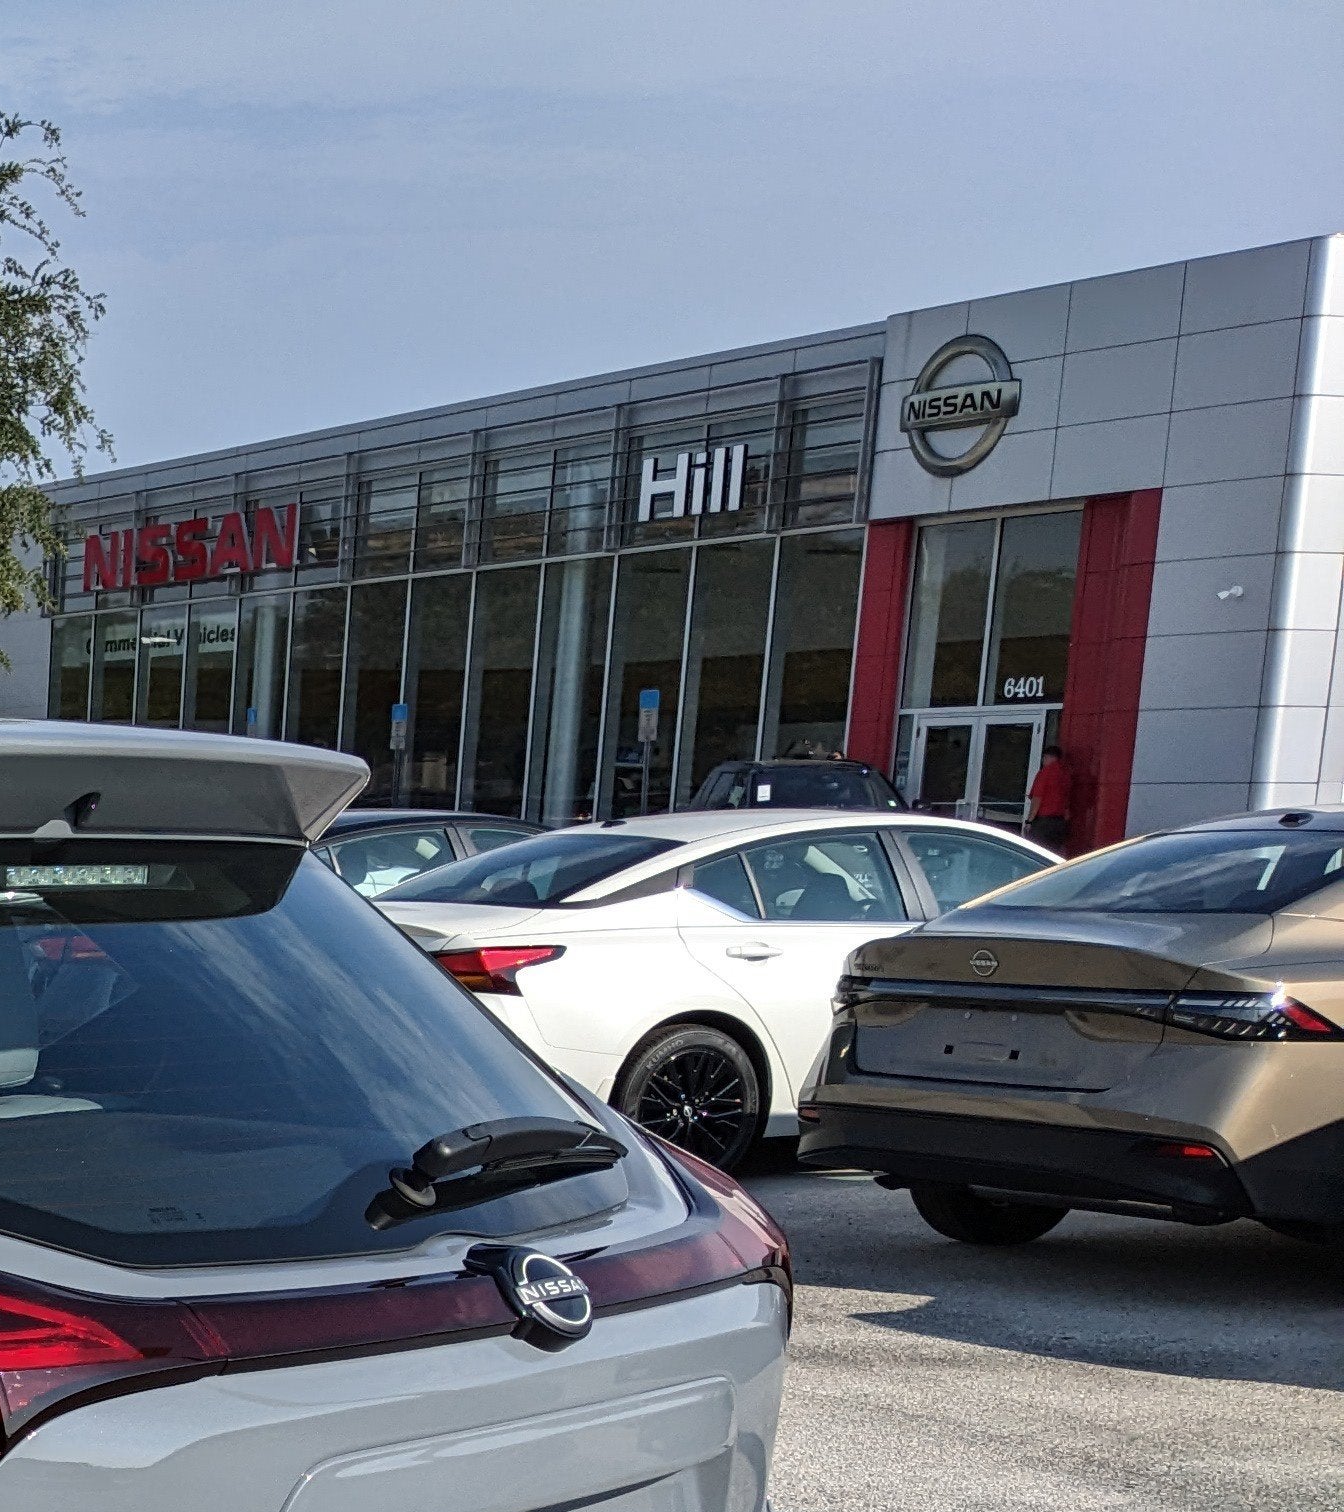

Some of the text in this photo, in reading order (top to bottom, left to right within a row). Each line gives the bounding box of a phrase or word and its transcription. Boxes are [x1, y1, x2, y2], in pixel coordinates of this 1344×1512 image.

[908, 388, 1002, 422] NISSAN
[638, 444, 748, 523] Hill
[83, 503, 299, 592] NISSAN
[1003, 676, 1044, 698] 6401
